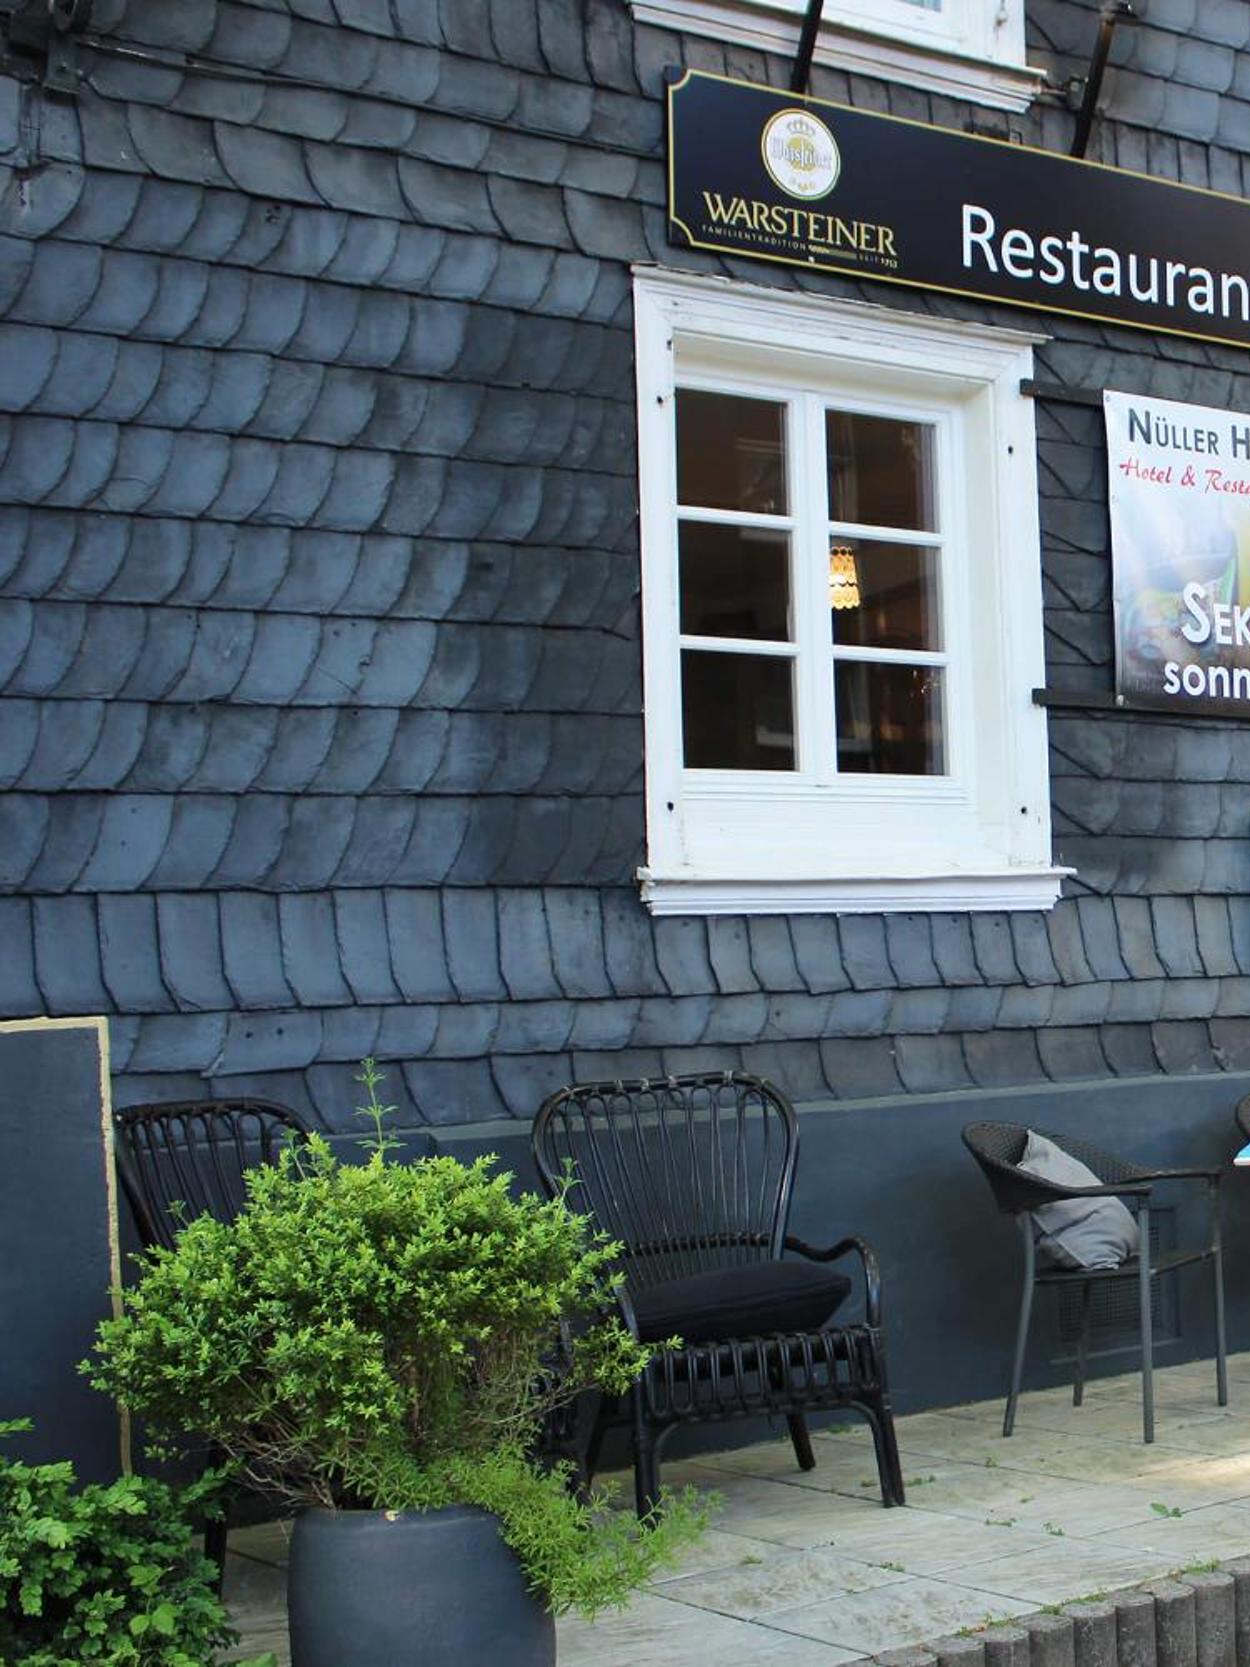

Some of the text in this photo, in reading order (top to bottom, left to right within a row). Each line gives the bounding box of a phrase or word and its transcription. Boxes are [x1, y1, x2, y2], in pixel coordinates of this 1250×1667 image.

[702, 191, 897, 256] WARSTEINER
[702, 224, 806, 252] FAMILIENTRADITION
[1128, 408, 1220, 456] NÜLLER
[1119, 455, 1173, 484] Hotel
[1181, 465, 1196, 487] &
